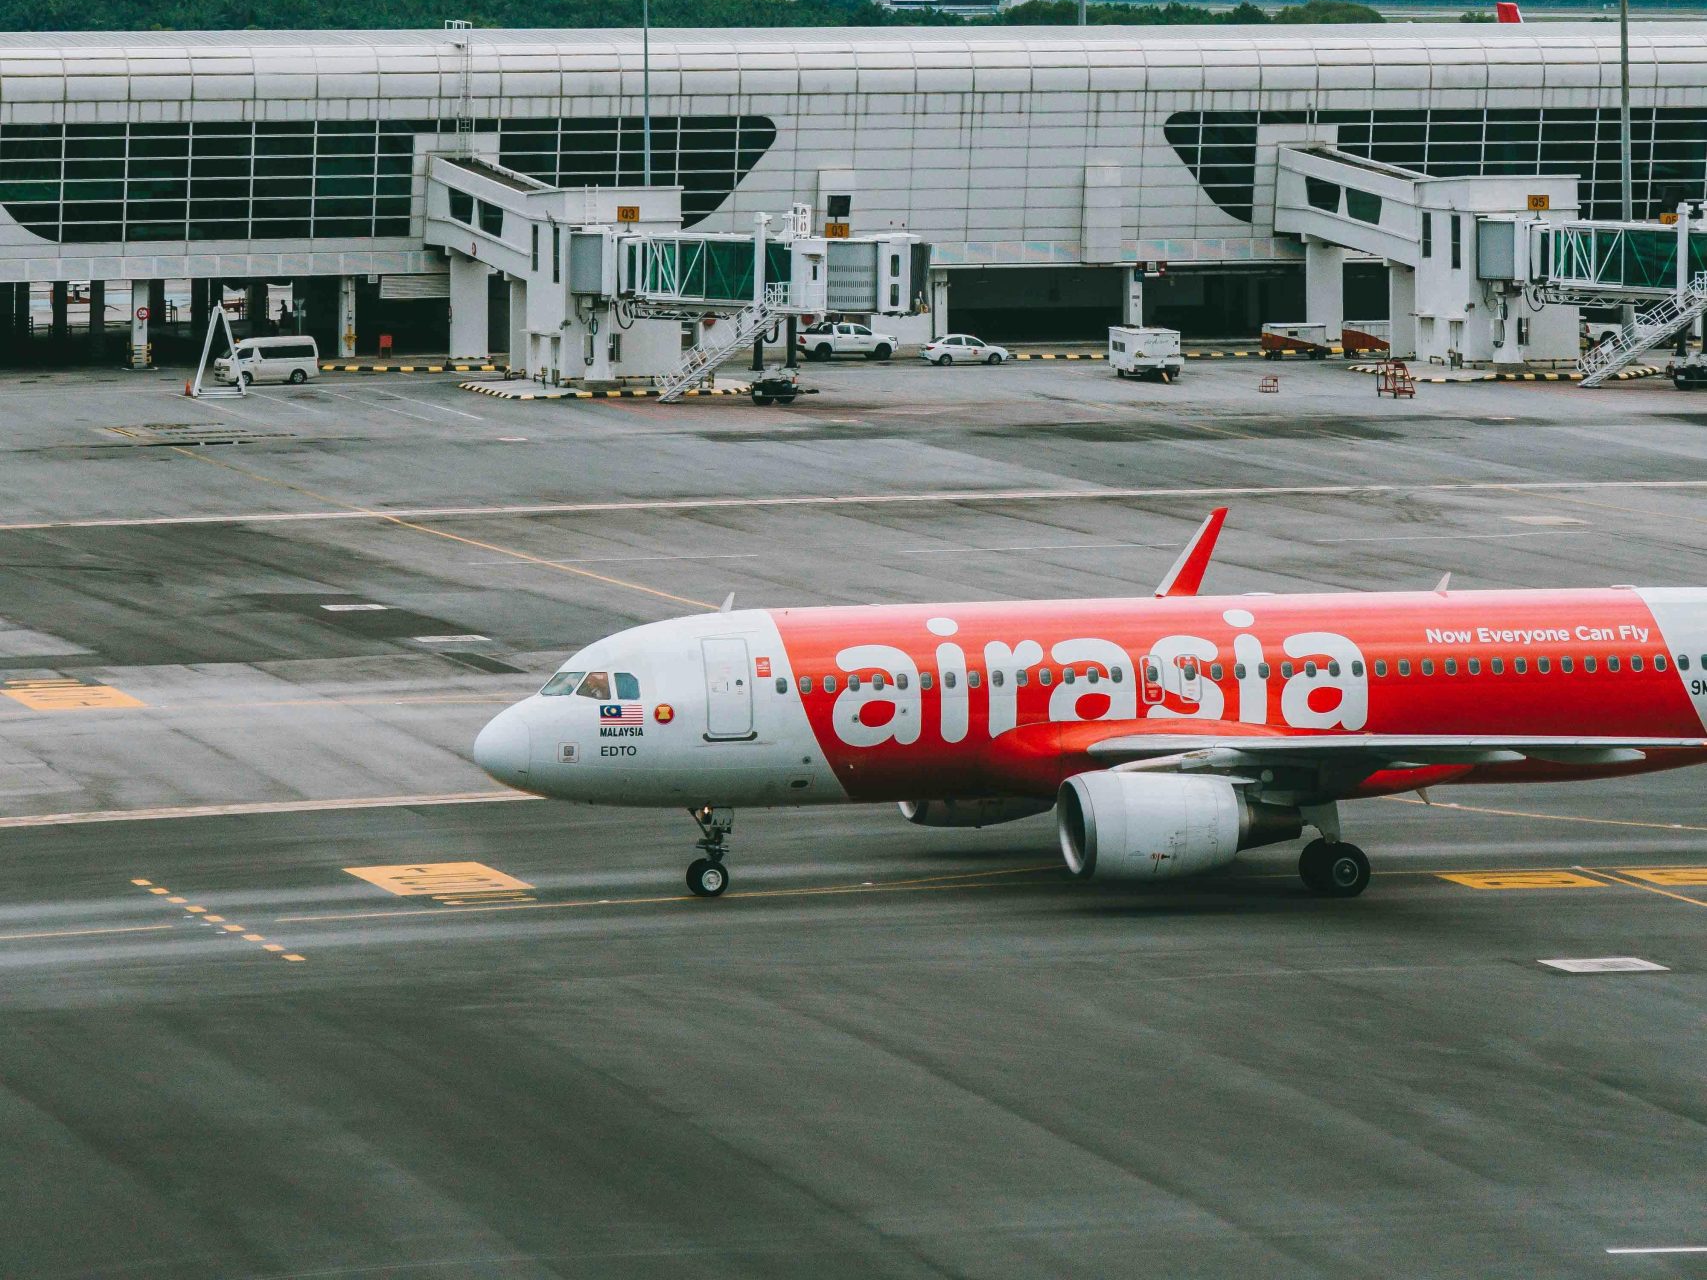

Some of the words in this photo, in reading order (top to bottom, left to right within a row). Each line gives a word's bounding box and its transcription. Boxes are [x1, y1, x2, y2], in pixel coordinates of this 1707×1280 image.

[1426, 628, 1472, 644] Now
[1476, 627, 1570, 645] Everyone
[1575, 625, 1614, 641] Can
[1618, 625, 1649, 643] Fly
[832, 609, 1368, 747] airasia
[600, 727, 644, 737] MALAYSIA
[600, 745, 637, 757] EDTO
